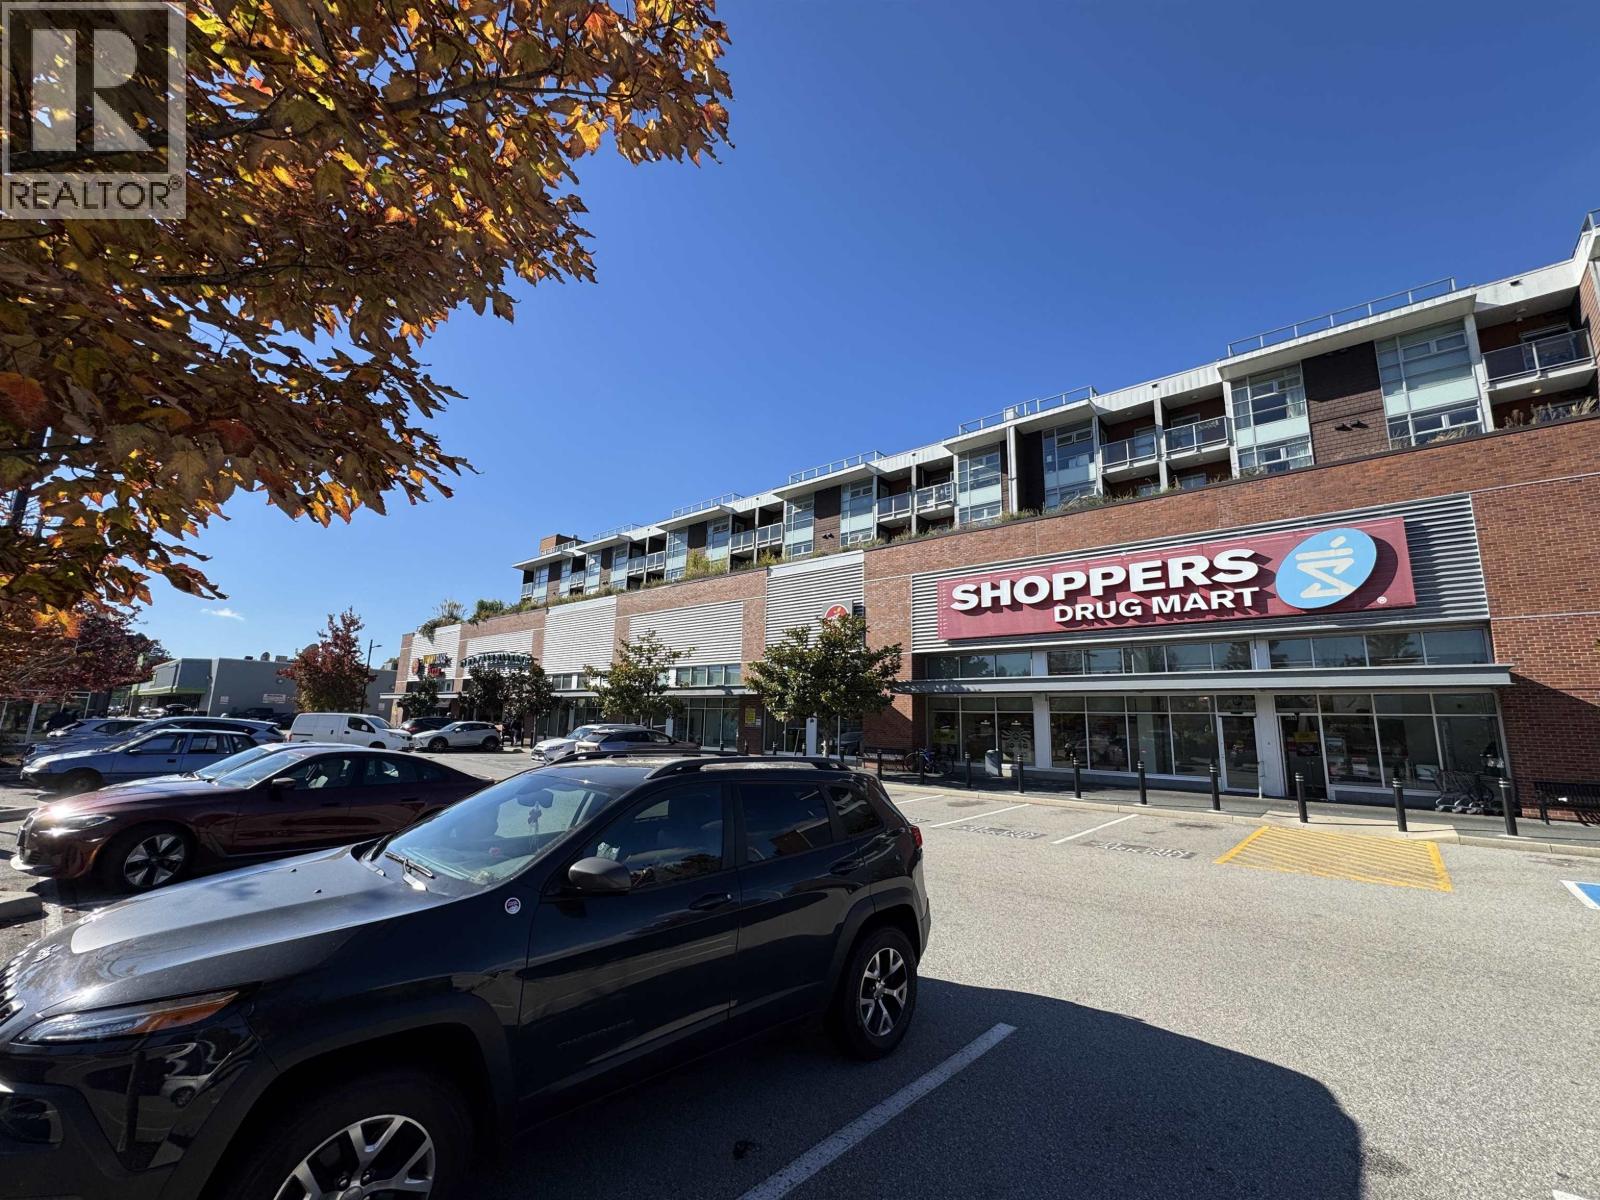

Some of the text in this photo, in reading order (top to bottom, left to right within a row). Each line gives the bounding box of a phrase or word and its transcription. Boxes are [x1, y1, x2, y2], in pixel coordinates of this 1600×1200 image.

[951, 549, 1259, 611] SHOPPERS
[1054, 588, 1260, 623] DRUG MART
